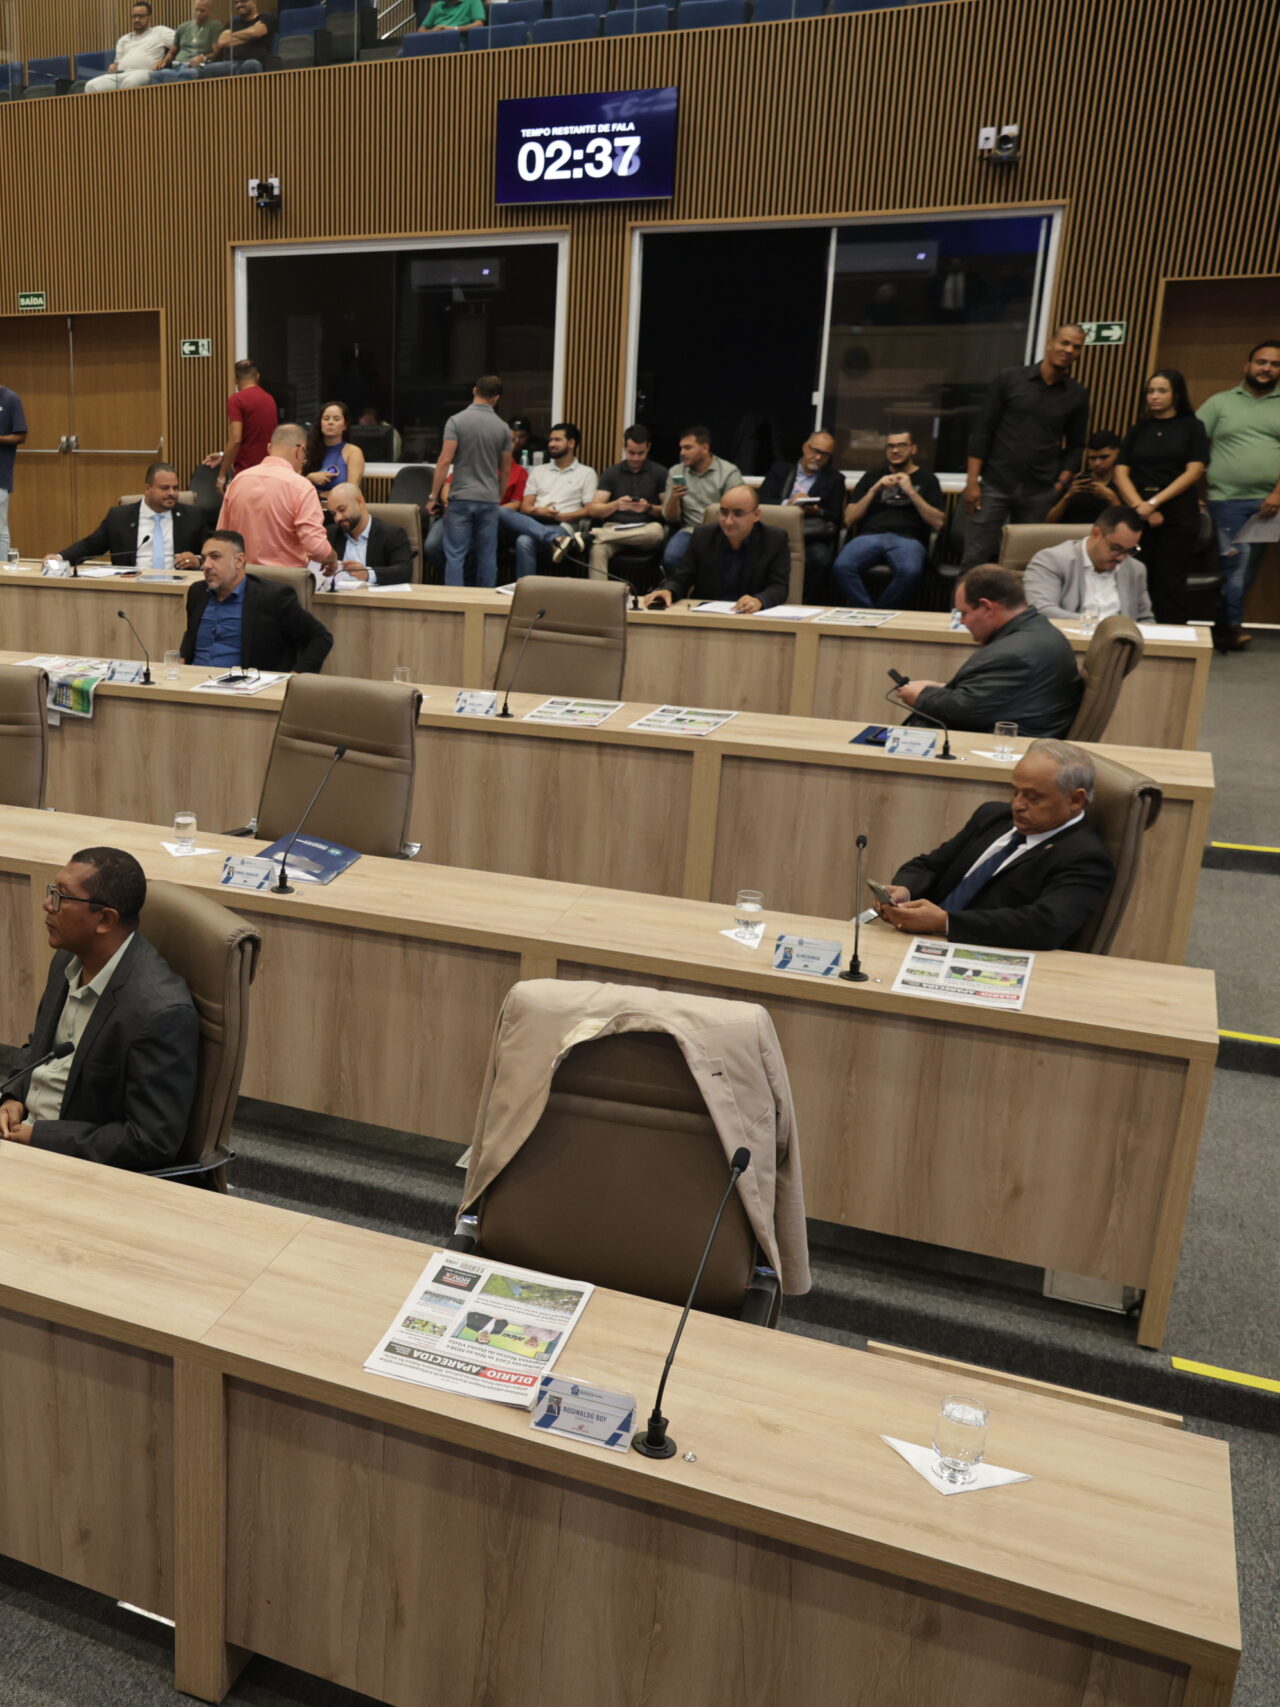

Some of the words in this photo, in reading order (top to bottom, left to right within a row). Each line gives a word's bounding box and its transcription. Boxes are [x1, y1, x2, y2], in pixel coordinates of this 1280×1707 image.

[521, 128, 551, 138] TEMPO
[552, 125, 597, 136] RESTANTE
[597, 124, 611, 133] DE
[611, 122, 635, 132] FALA
[517, 136, 641, 182] 02:37
[20, 296, 44, 305] SAÍDA
[412, 1350, 481, 1374] APARECIDA
[486, 1369, 533, 1385] DIÁRIO
[563, 1406, 595, 1420] ROSINALDO
